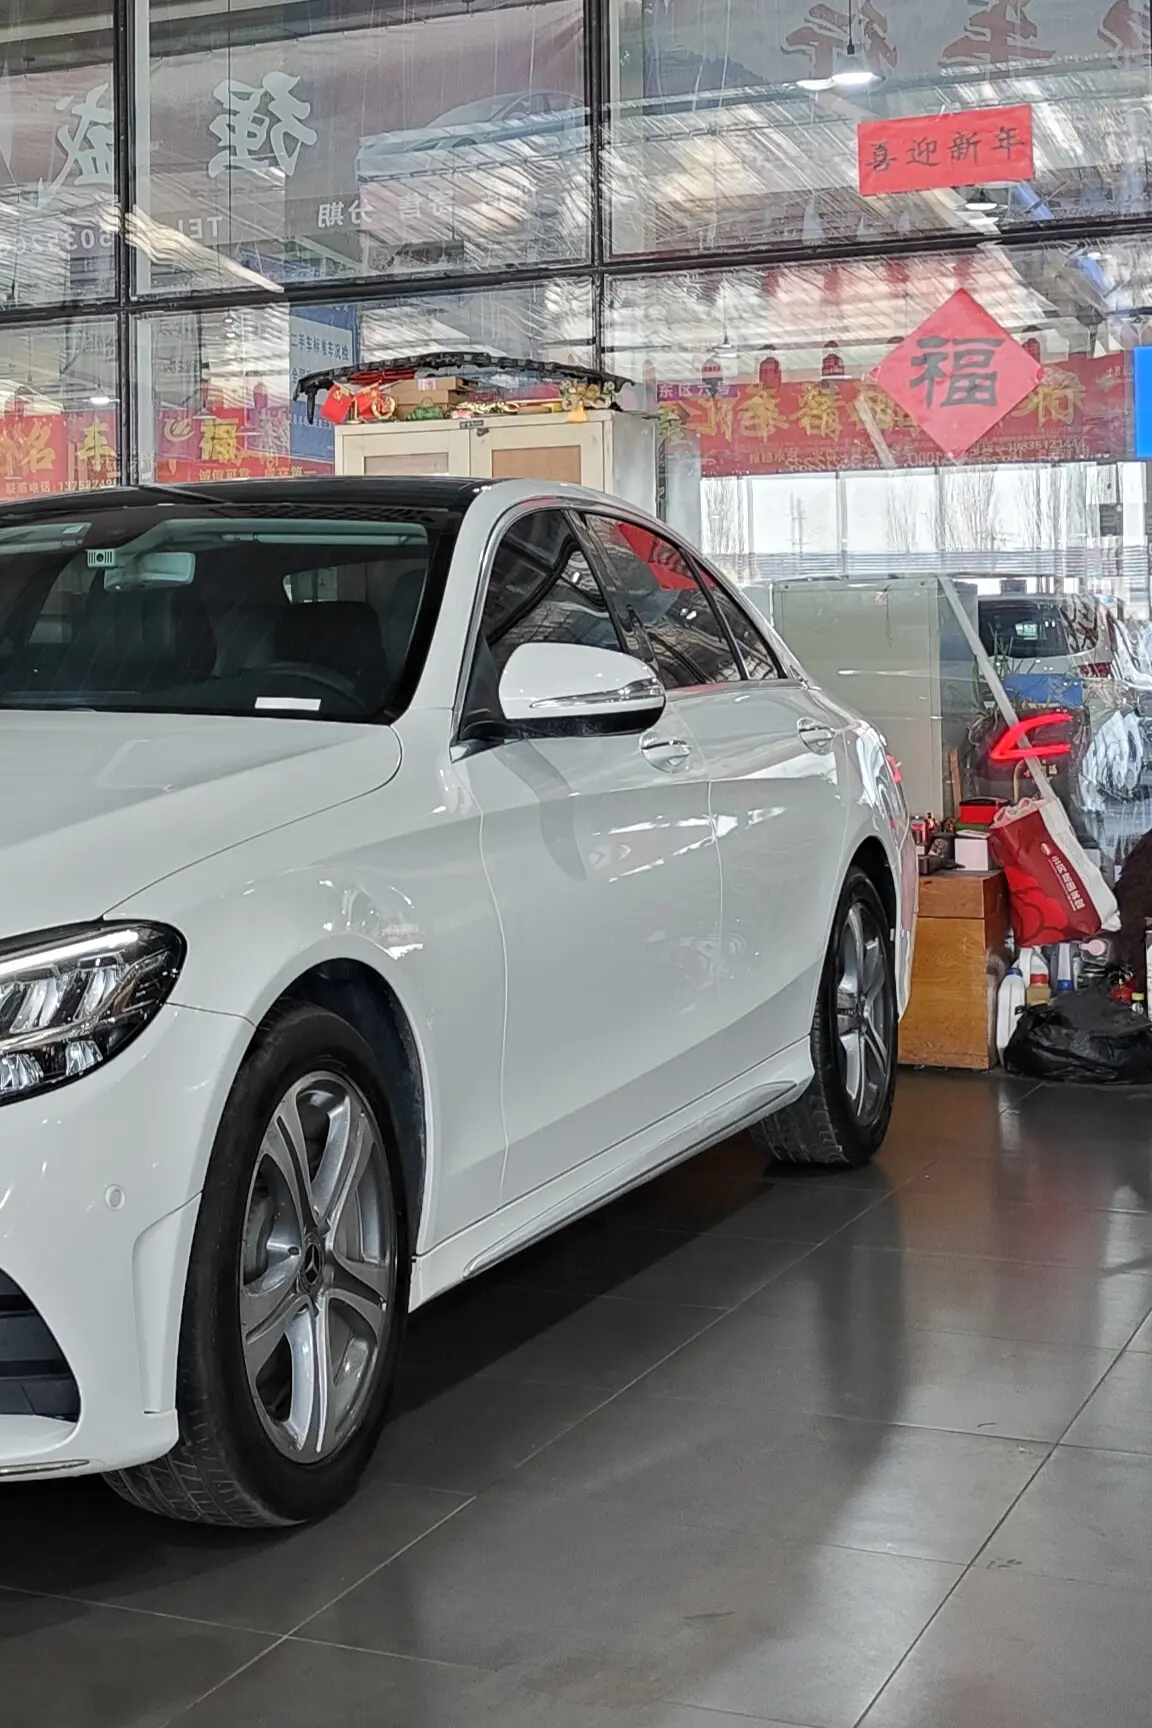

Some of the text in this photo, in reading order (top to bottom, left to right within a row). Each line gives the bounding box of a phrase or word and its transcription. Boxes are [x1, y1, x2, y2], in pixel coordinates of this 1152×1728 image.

[865, 126, 1025, 171] 喜迎新年
[909, 336, 1006, 408] 福
